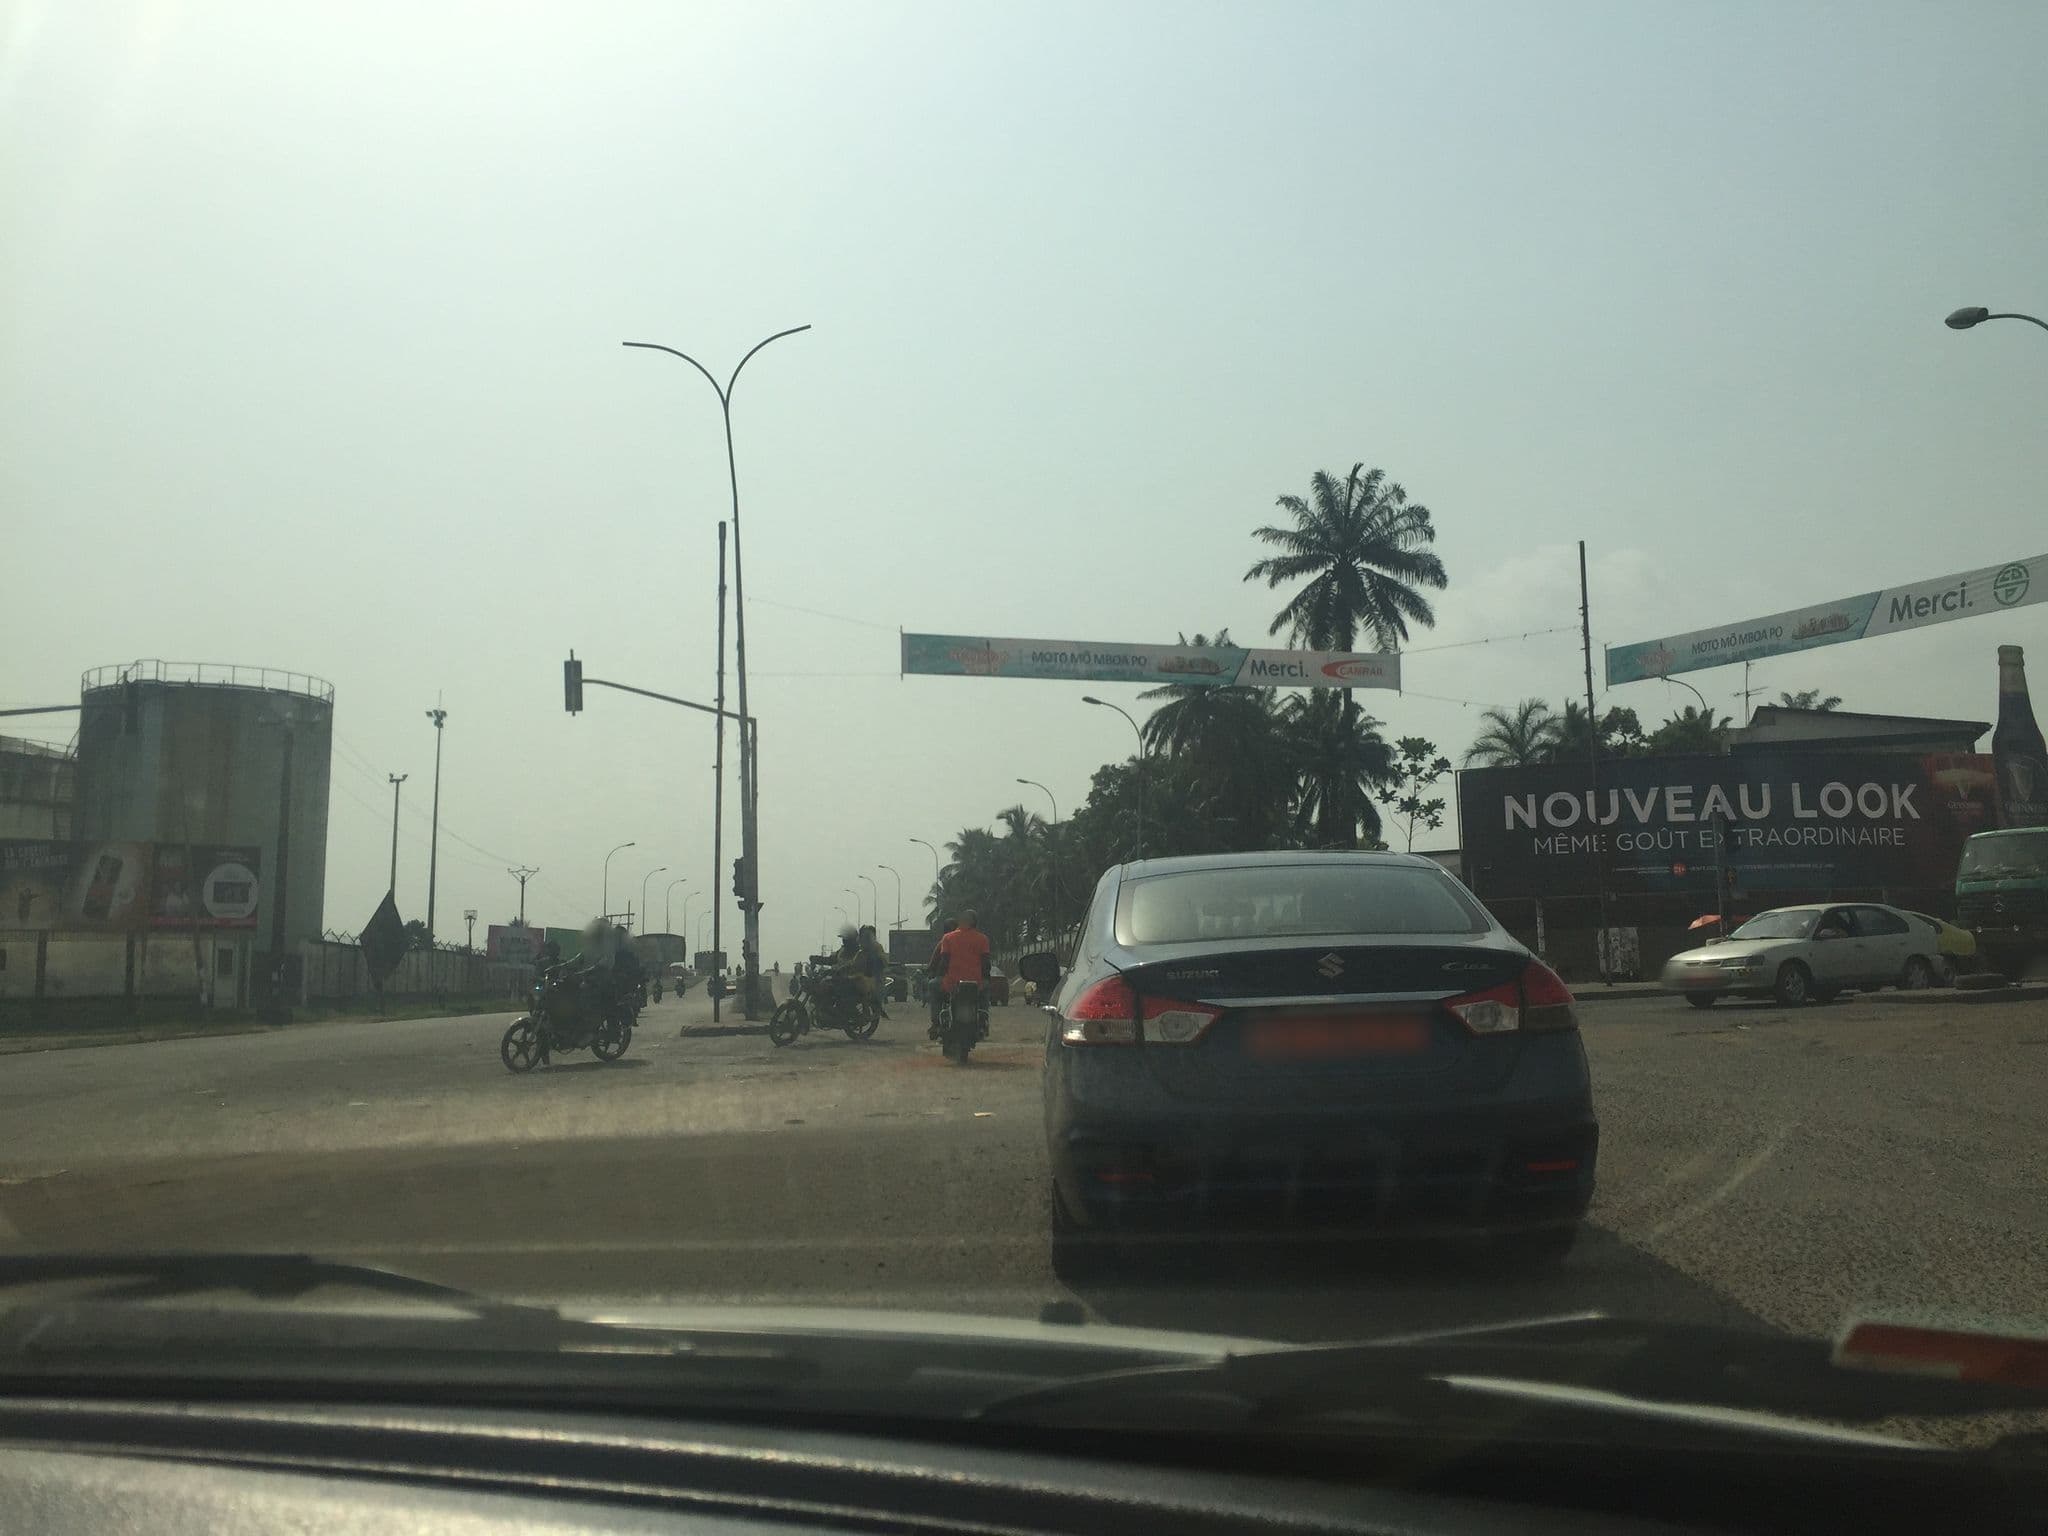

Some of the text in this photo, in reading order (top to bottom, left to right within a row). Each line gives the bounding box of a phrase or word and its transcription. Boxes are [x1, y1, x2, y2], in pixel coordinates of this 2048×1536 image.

[1889, 581, 1973, 623] Merci.
[1692, 638, 1719, 655] MOTO
[1738, 629, 1769, 645] MBOA
[1031, 651, 1068, 664] MOTO
[1094, 653, 1129, 665] MBOA
[1250, 659, 1309, 678] Merci.
[1340, 665, 1384, 677] CAMRAIL
[1504, 781, 1921, 830] NOUVEAU LOOK
[1534, 832, 1607, 854] MÊME
[1616, 827, 1689, 851] GOÛT
